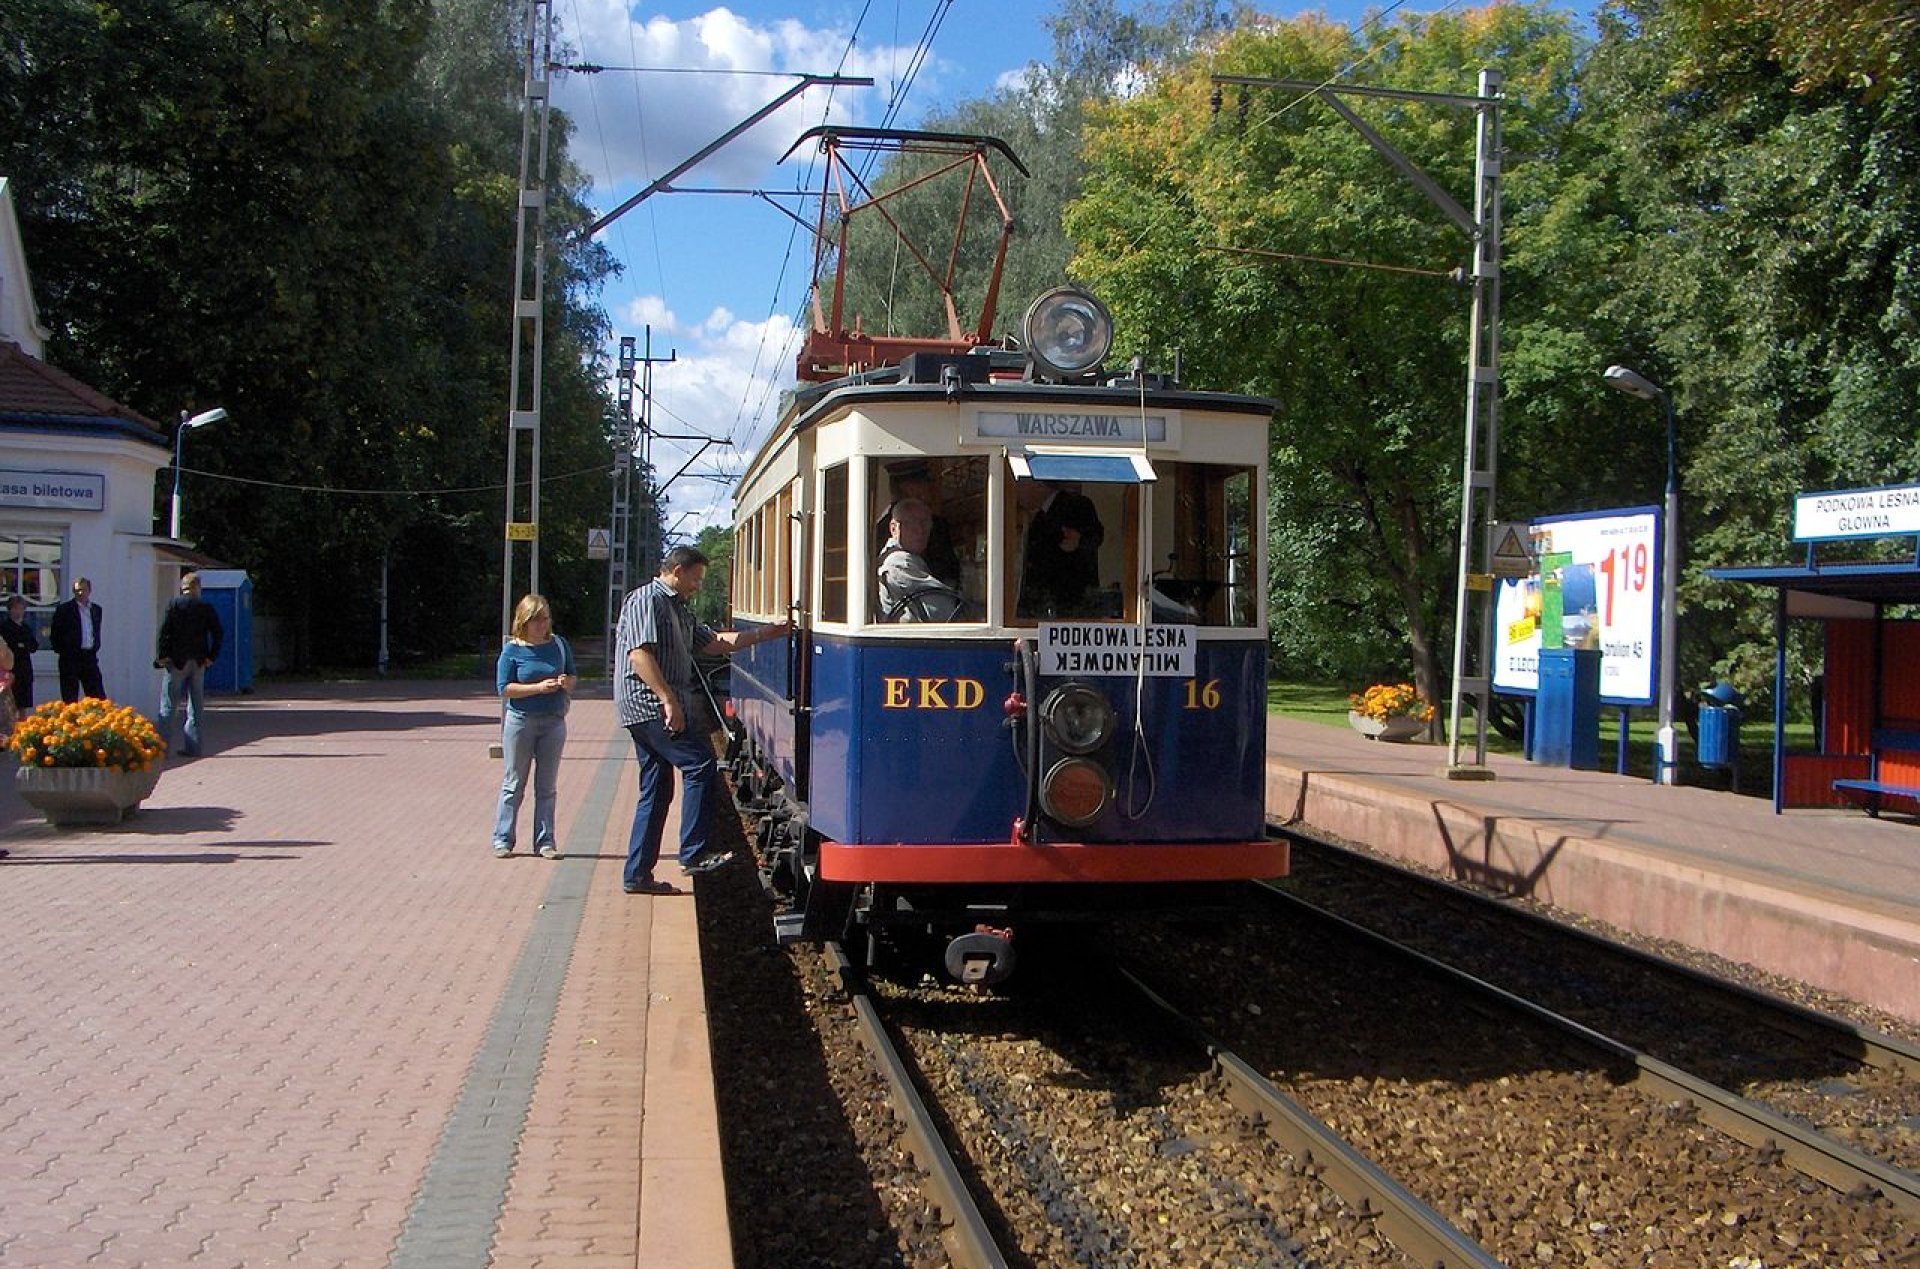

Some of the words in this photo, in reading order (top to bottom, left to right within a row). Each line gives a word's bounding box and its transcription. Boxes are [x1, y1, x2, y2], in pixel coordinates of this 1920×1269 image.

[1016, 413, 1122, 437] WARSZAWA
[0, 484, 28, 495] asa
[33, 484, 94, 499] biletowa
[1816, 496, 1875, 513] PODKOWA
[1050, 627, 1129, 647] PODKOWA
[1133, 625, 1188, 647] LEŚNA
[882, 677, 986, 709] EKD
[1182, 678, 1222, 711] 16
